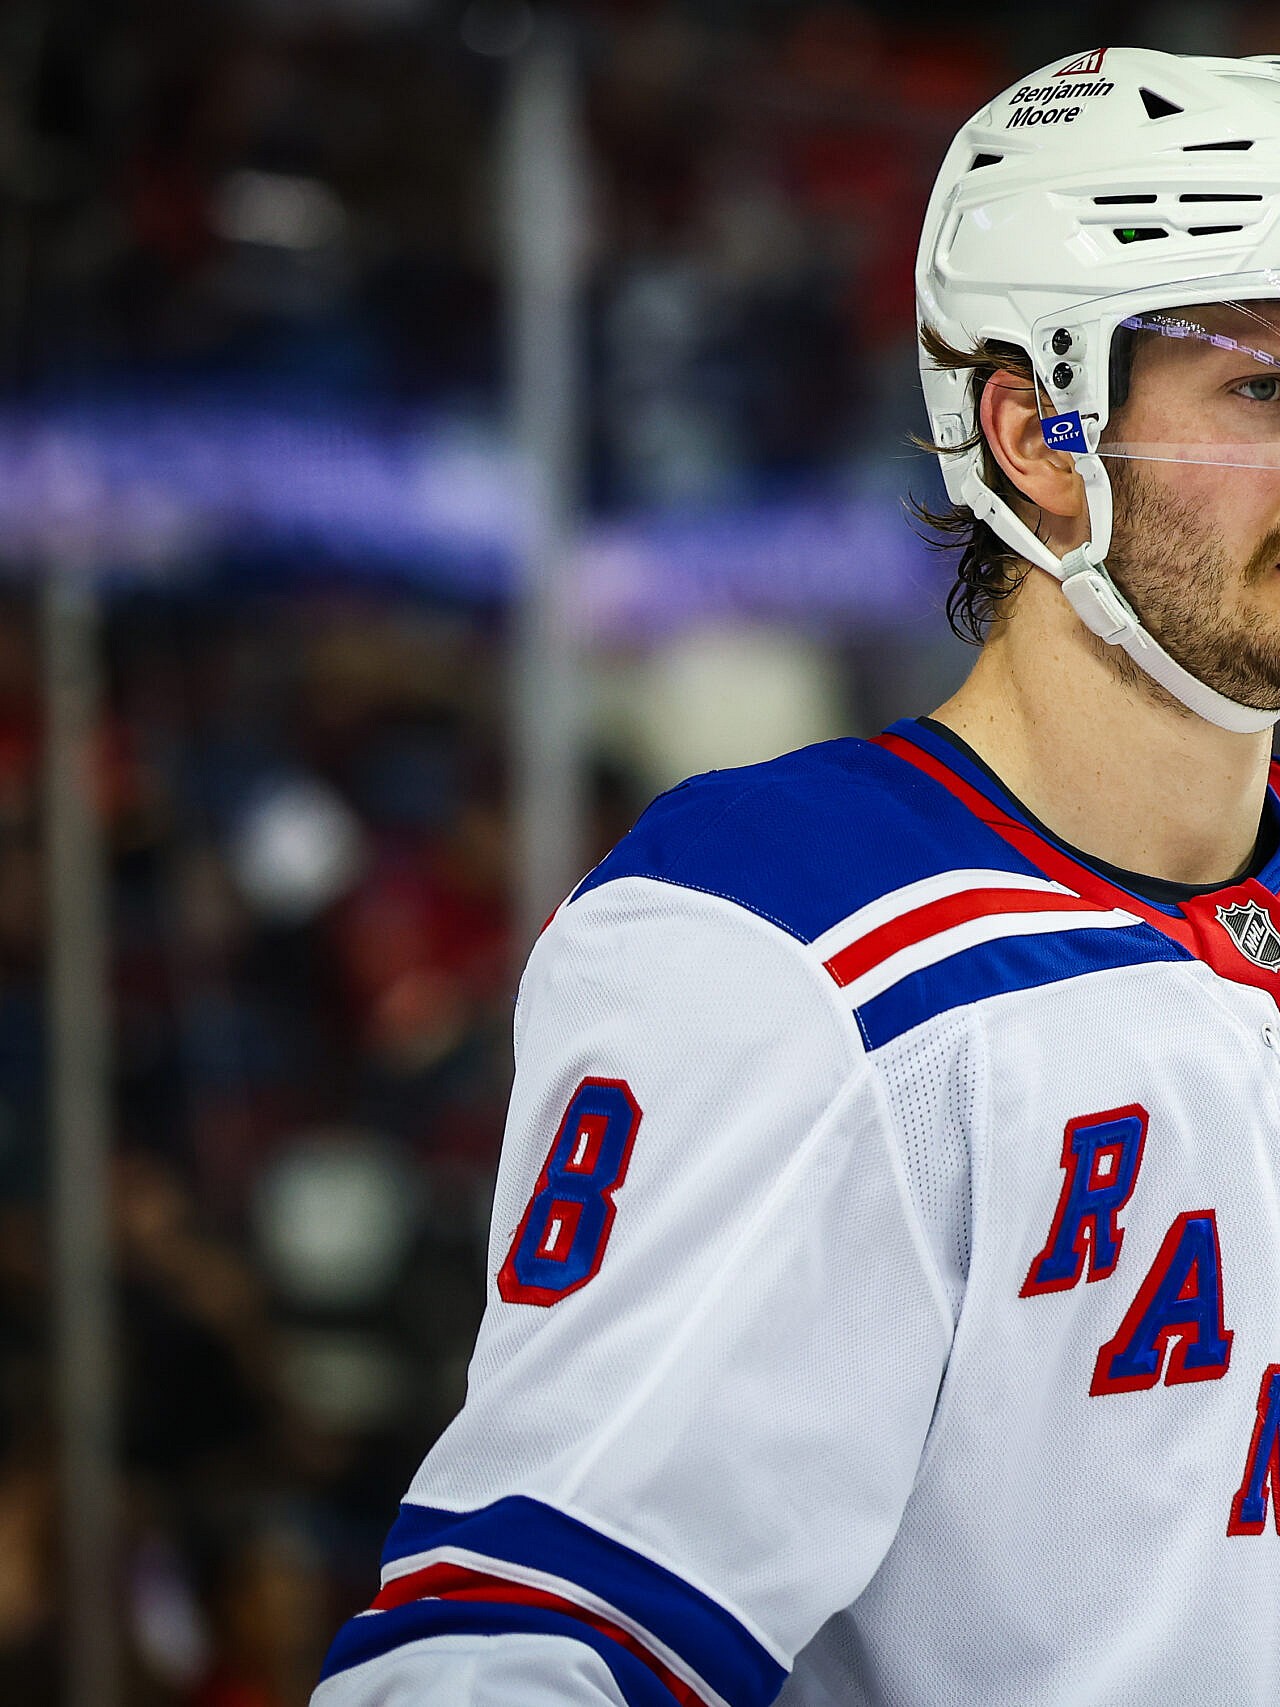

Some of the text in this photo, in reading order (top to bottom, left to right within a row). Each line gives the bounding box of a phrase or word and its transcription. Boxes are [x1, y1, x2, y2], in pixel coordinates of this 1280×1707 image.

[1008, 77, 1115, 106] Benjamin
[1005, 106, 1081, 129] Moore
[1047, 430, 1080, 444] OAKLEY
[1244, 919, 1266, 956] NHL
[497, 1076, 644, 1308] 8
